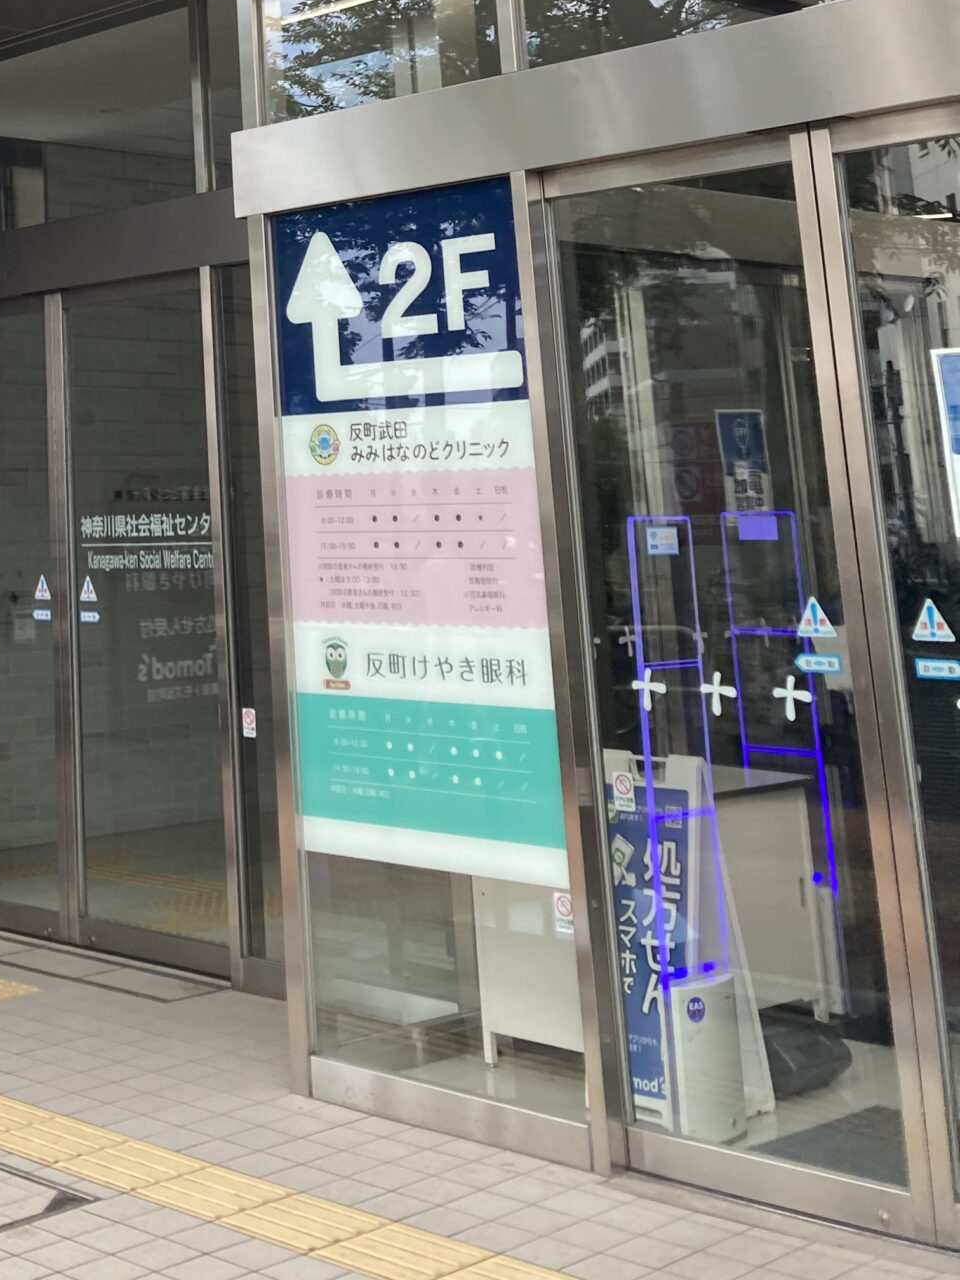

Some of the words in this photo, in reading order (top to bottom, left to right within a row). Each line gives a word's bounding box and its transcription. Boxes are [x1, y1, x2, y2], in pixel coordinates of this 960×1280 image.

[378, 232, 497, 339] 2F
[349, 421, 408, 442] 反町武田
[350, 437, 510, 463] みみはなのどクリニック
[88, 551, 138, 571] Kanagawa-ken
[139, 550, 162, 569] Social
[163, 550, 191, 569] Welfare
[366, 652, 529, 687] 反町けやき眼科
[618, 899, 638, 995] スマホで
